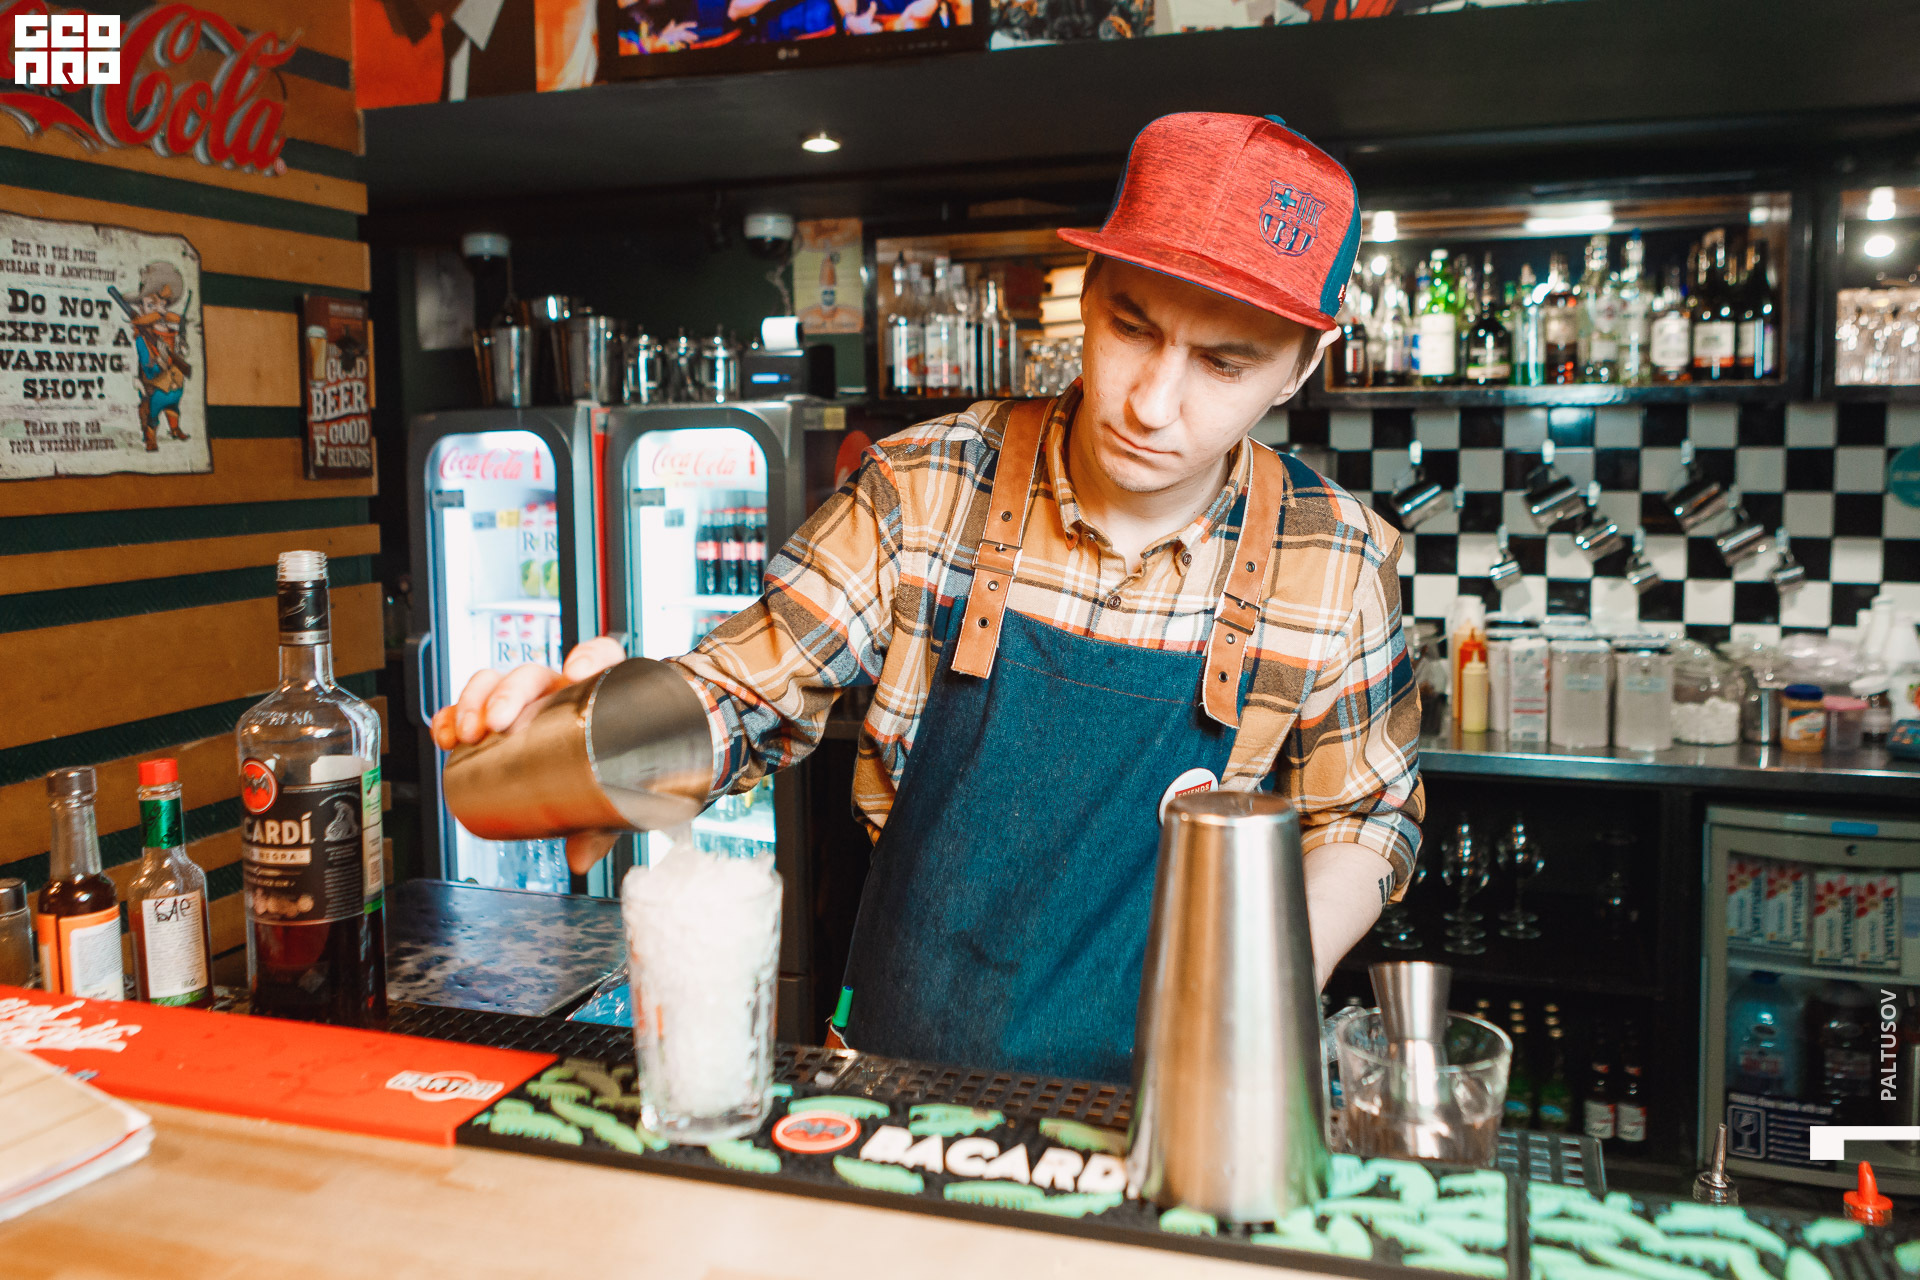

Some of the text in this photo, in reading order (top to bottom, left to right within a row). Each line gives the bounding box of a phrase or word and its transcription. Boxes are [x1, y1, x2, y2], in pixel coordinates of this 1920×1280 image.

[97, 2, 302, 174] Cola
[59, 296, 112, 320] NOT
[113, 327, 132, 346] A
[23, 376, 105, 400] SHOT!
[310, 381, 369, 421] BEER
[329, 418, 370, 445] GOOD
[314, 435, 371, 468] FRIENDS
